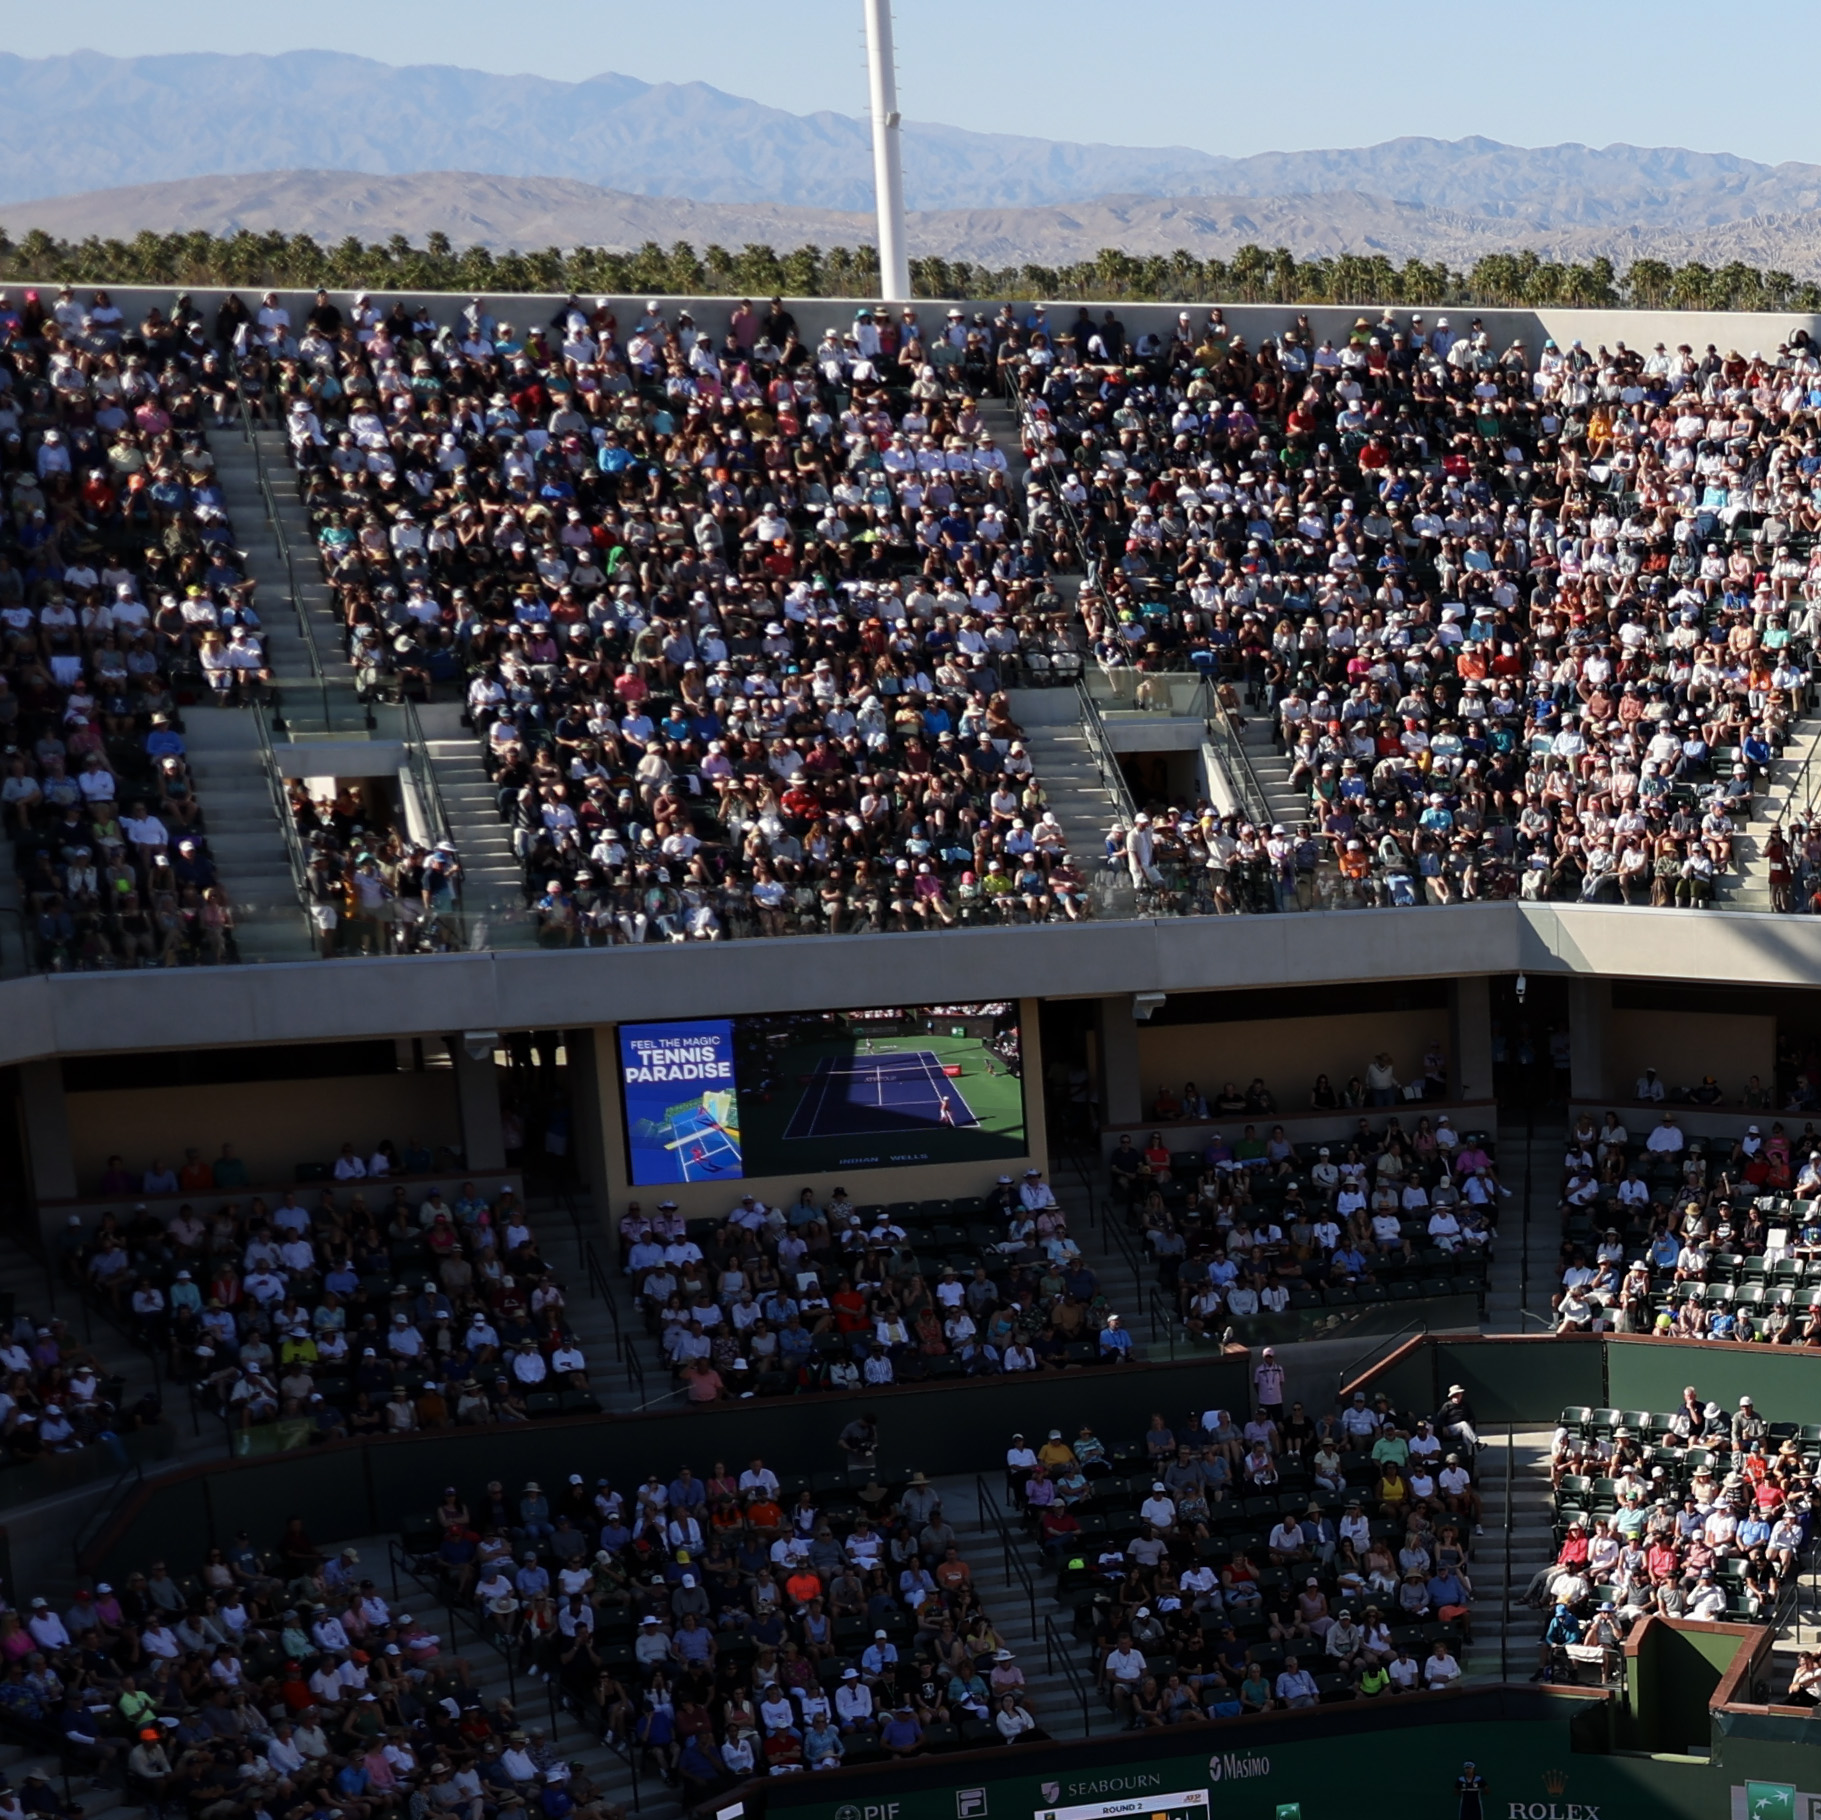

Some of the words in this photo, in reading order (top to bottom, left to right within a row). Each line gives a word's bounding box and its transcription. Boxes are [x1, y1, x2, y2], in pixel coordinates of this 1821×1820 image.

[630, 1040, 657, 1050] FEEL
[659, 1038, 680, 1048] THE
[683, 1036, 721, 1047] MAGIC
[637, 1046, 716, 1066] TENNIS
[625, 1062, 732, 1083] PARADISE
[1067, 1773, 1161, 1797] SEABOURN
[1102, 1804, 1135, 1814] ROUND
[1137, 1803, 1143, 1811] 2
